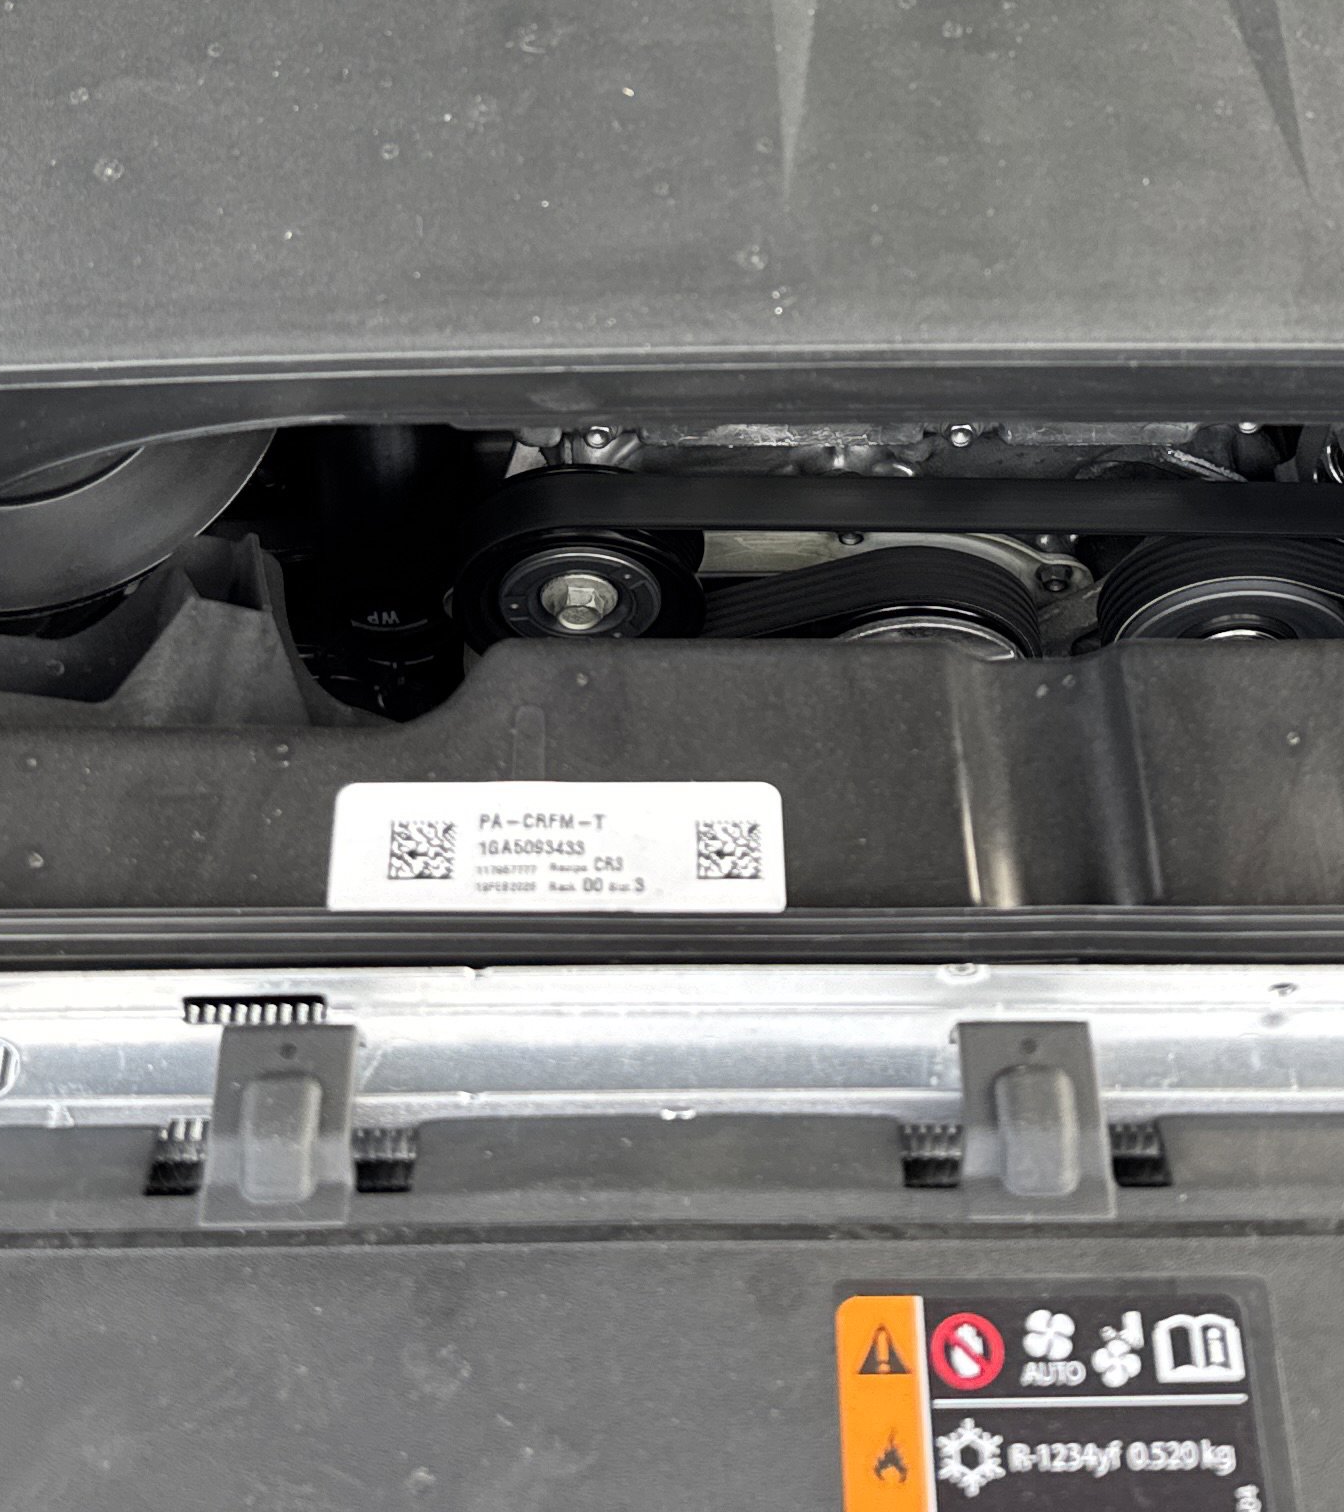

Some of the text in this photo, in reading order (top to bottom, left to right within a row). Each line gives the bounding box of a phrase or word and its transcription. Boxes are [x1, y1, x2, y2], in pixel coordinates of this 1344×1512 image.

[594, 857, 624, 872] CR3
[1020, 1361, 1086, 1387] AUTO
[1008, 1441, 1236, 1477] R-1234yf 0.520 kg
